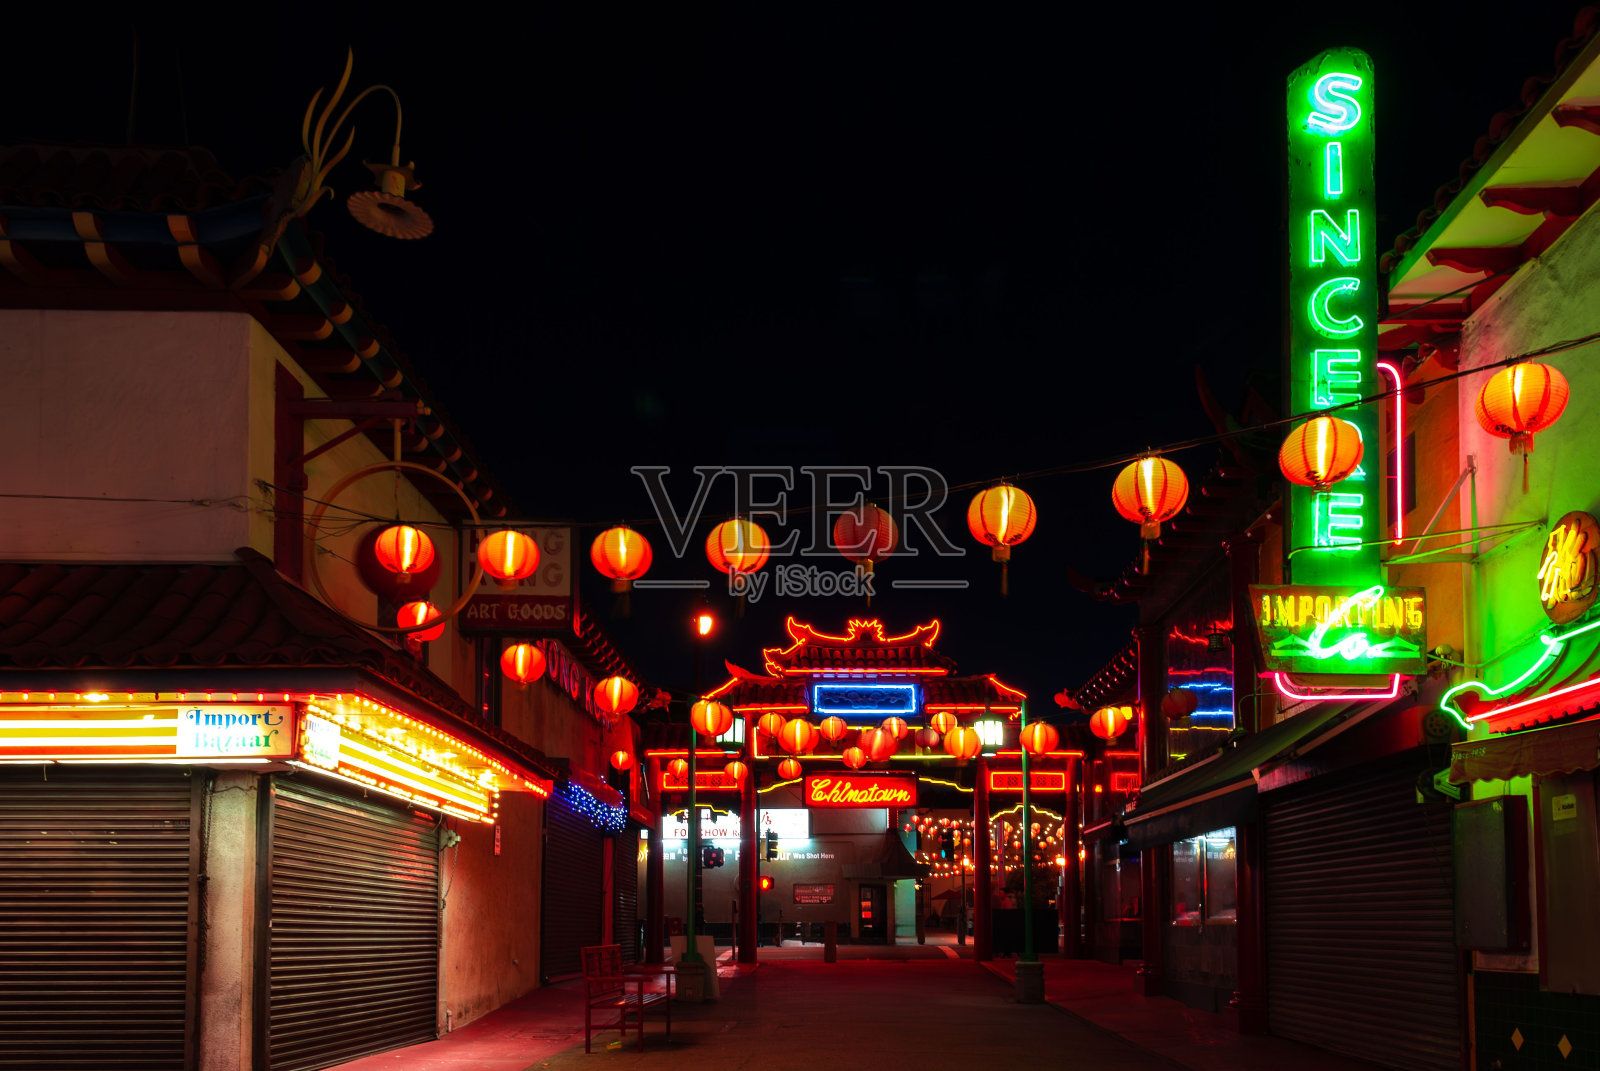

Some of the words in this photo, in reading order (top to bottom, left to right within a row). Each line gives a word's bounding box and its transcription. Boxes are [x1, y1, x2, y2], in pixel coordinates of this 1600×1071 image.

[1305, 71, 1365, 553] SINCEE
[466, 603, 500, 621] ART
[507, 603, 566, 621] GOODS
[186, 709, 284, 729] Import
[194, 729, 279, 753] Bazaar
[811, 778, 911, 803] Chinatown
[674, 828, 688, 837] FO
[702, 828, 728, 837] HOW
[806, 852, 820, 860] Shot
